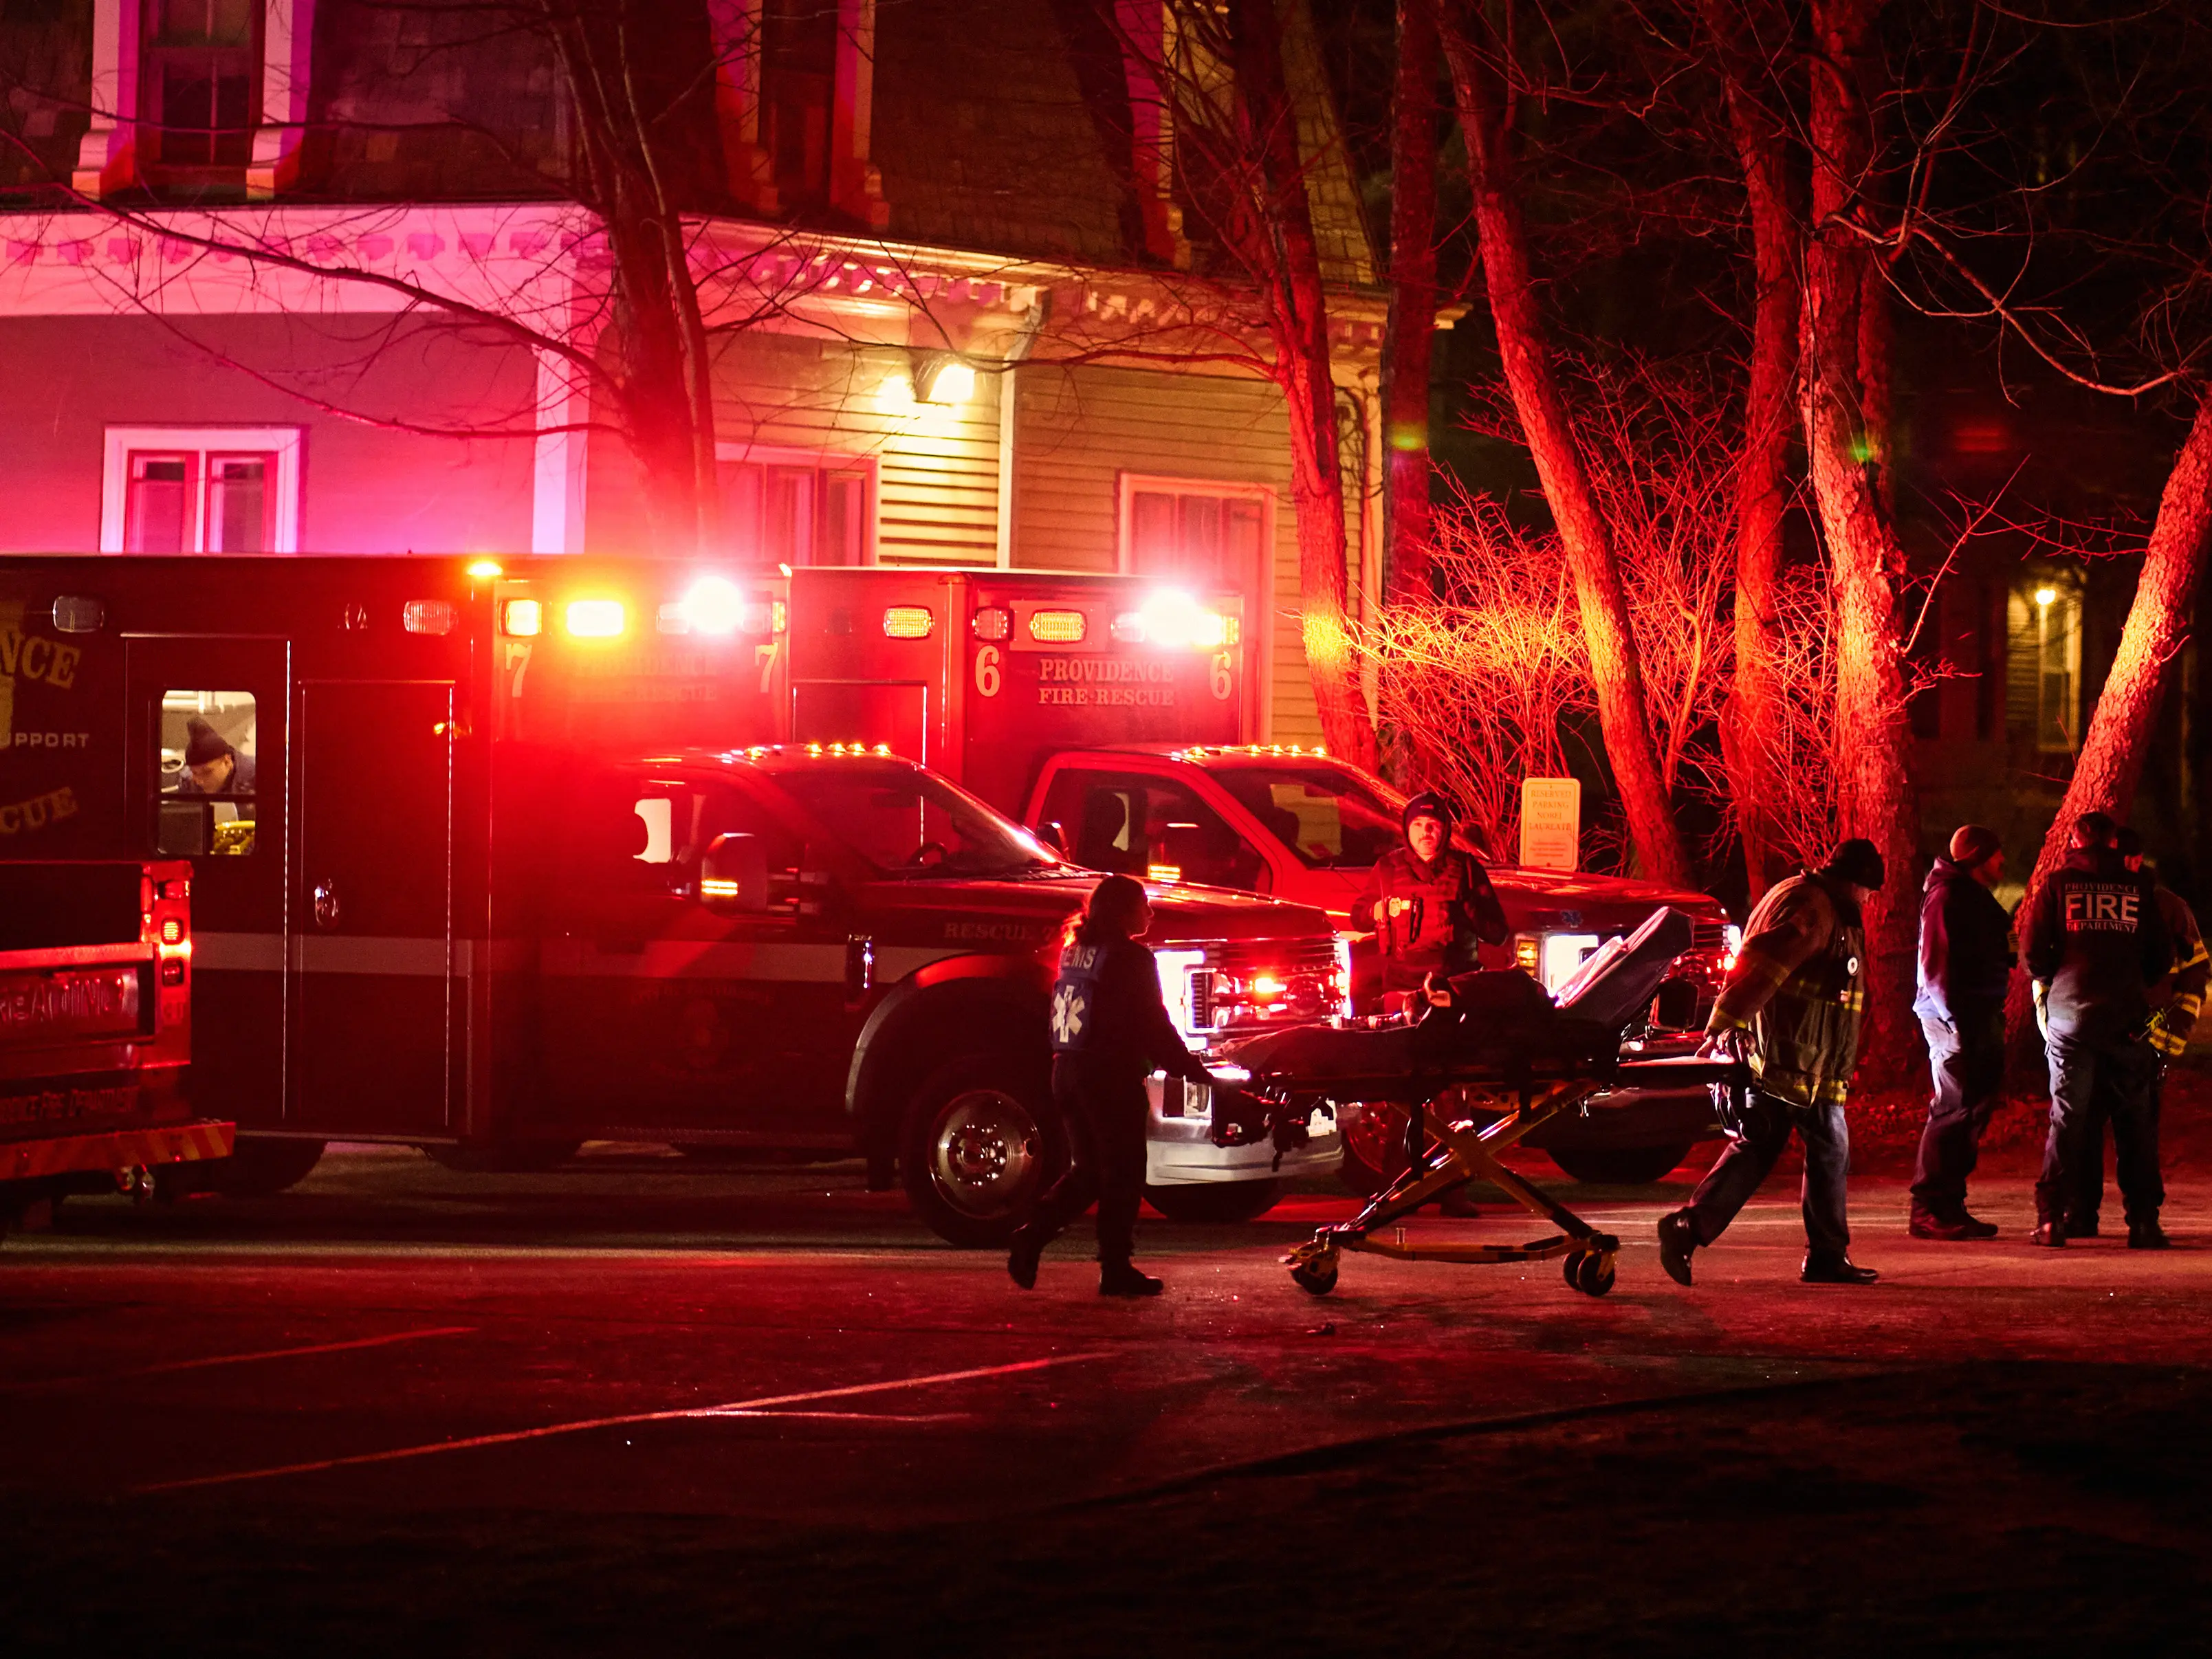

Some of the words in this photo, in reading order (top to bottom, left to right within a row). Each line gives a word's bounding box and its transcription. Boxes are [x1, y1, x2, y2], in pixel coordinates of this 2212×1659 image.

[505, 643, 533, 697] 7
[755, 641, 778, 693] 7
[975, 646, 1000, 696] 6
[1040, 658, 1174, 682] PROVIDENCE
[1209, 650, 1231, 700] 6
[1038, 688, 1088, 705] FIRE
[1095, 689, 1174, 706] RESCUE
[1531, 789, 1572, 798] RESERVED
[1532, 800, 1569, 809] PARKING
[1537, 811, 1562, 820] NOBEL
[2065, 882, 2138, 894] PROVIDENCE
[2066, 894, 2139, 921] FIRE
[943, 922, 1033, 941] RESCUE
[2066, 921, 2136, 933] DEPARTMENT
[1062, 945, 1097, 969] EMS
